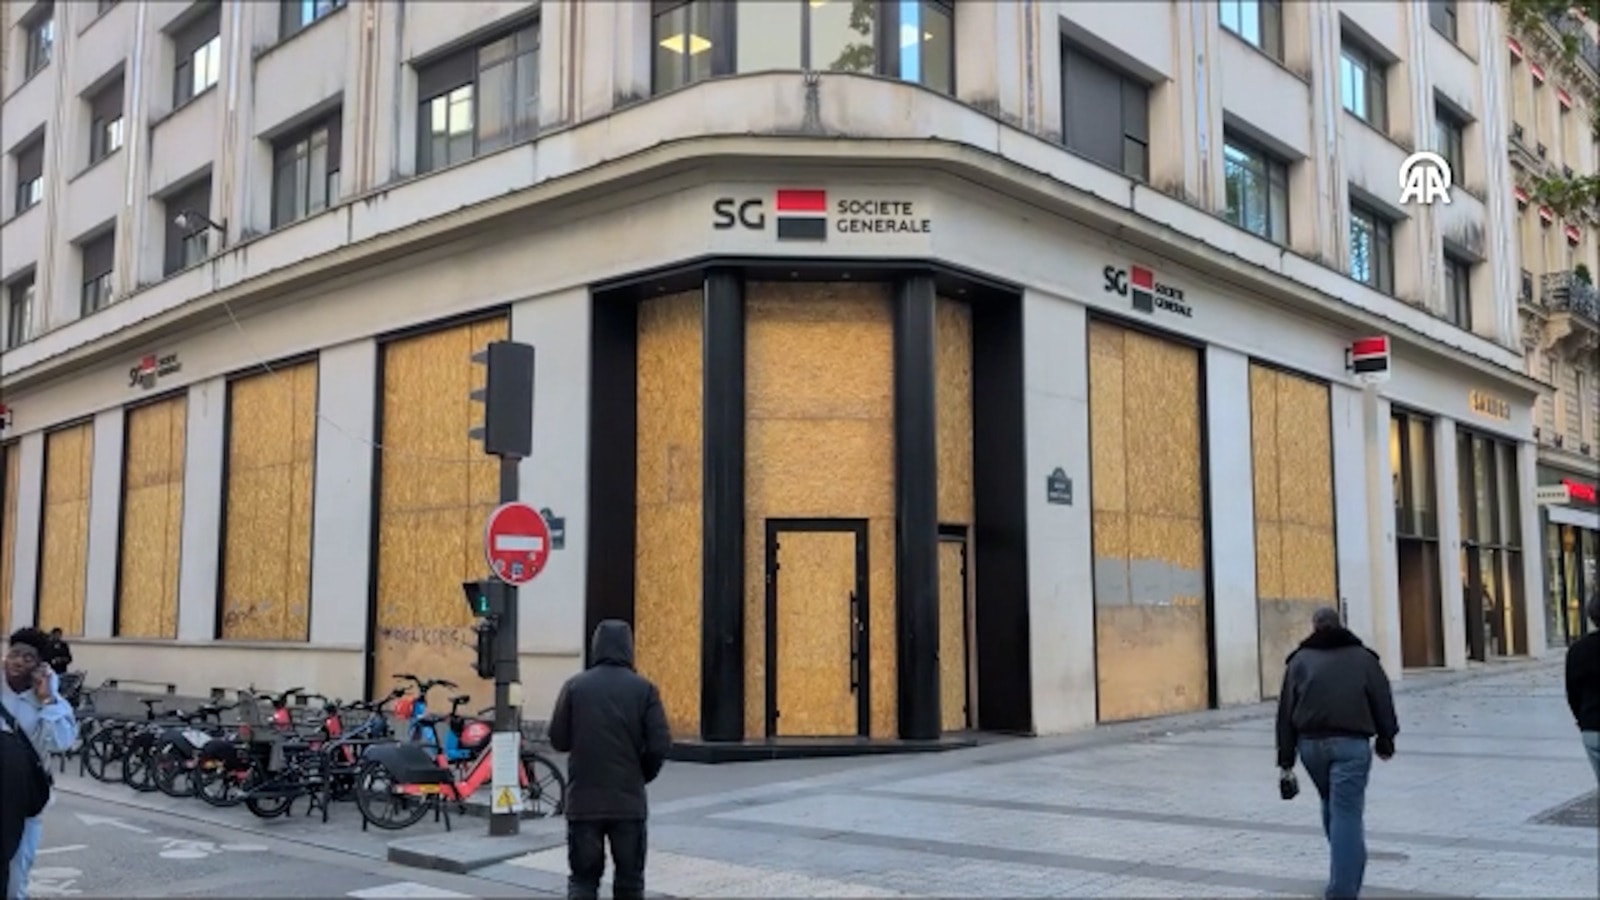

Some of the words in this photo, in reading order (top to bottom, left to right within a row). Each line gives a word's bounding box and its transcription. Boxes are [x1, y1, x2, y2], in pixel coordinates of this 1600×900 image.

[713, 198, 765, 230] SG
[837, 199, 912, 216] SOCIETE
[836, 219, 931, 233] GENERALE
[1103, 265, 1128, 297] SG
